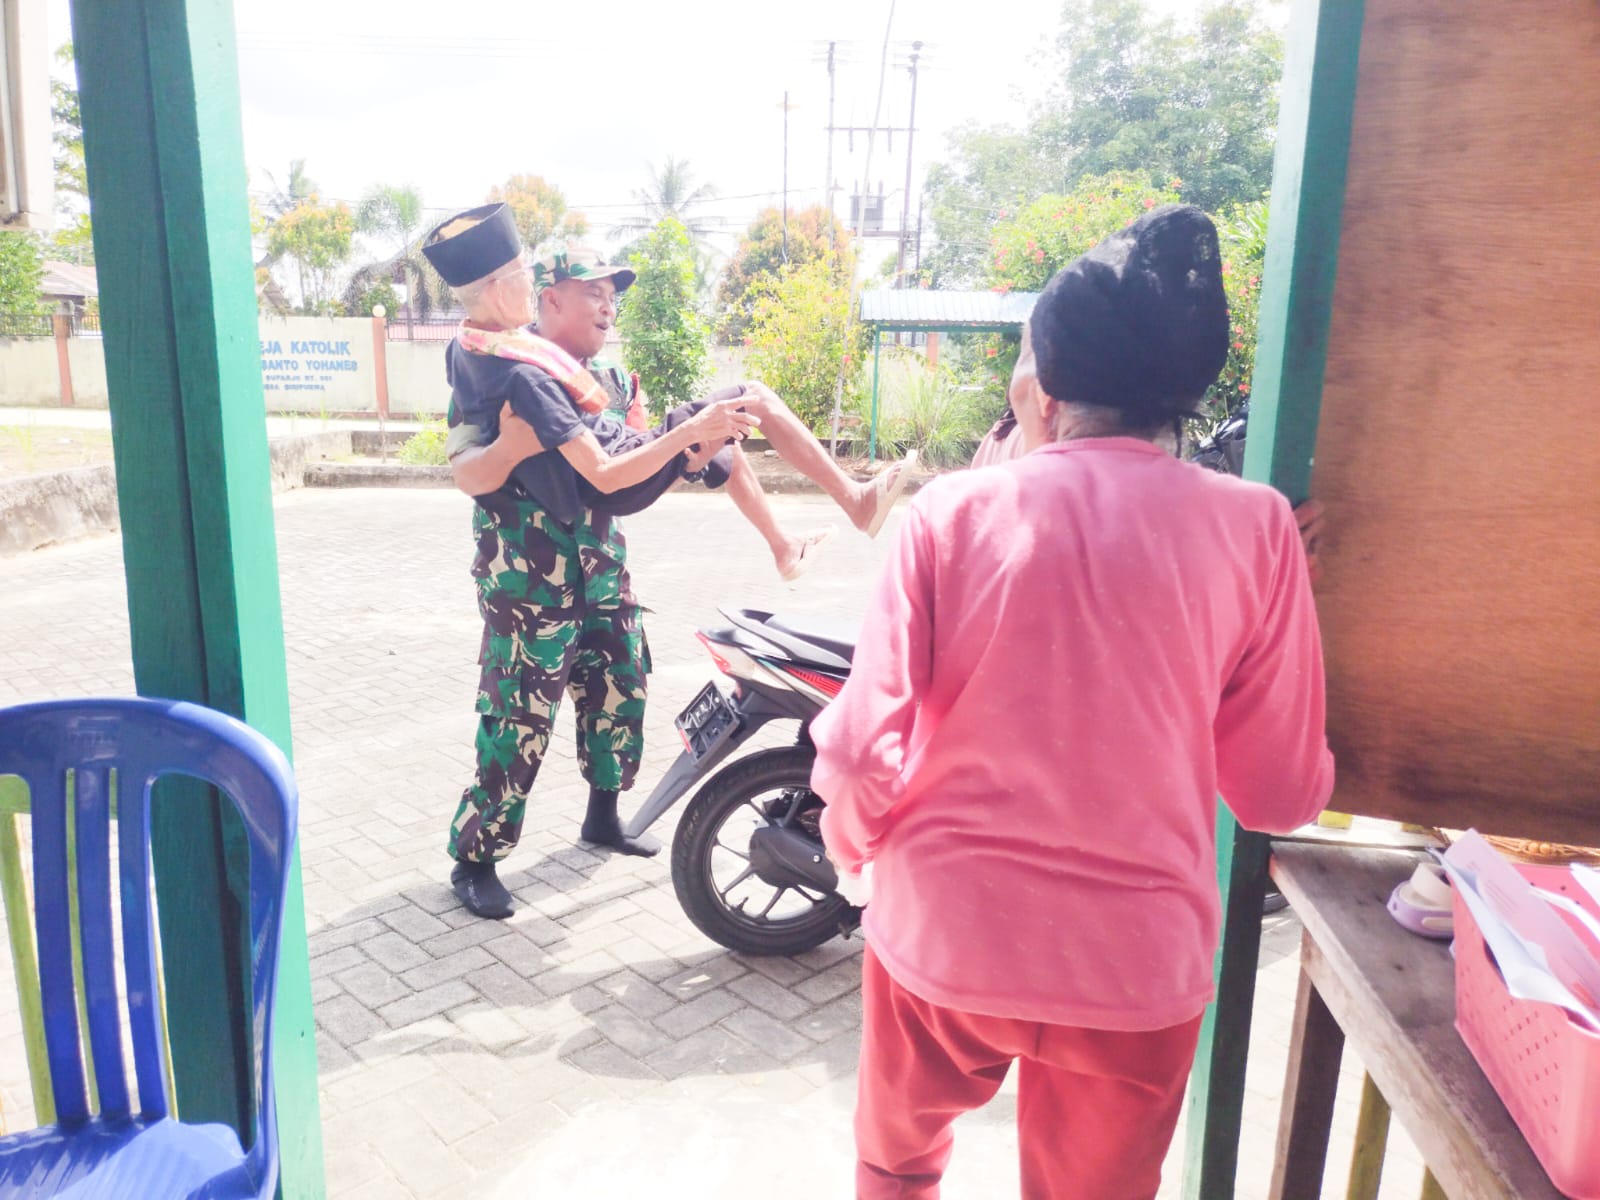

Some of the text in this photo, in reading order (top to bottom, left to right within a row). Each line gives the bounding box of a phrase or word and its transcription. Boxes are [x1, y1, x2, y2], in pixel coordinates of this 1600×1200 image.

[290, 341, 351, 356] KATOLIK
[262, 360, 358, 371] SANTO YOHANES
